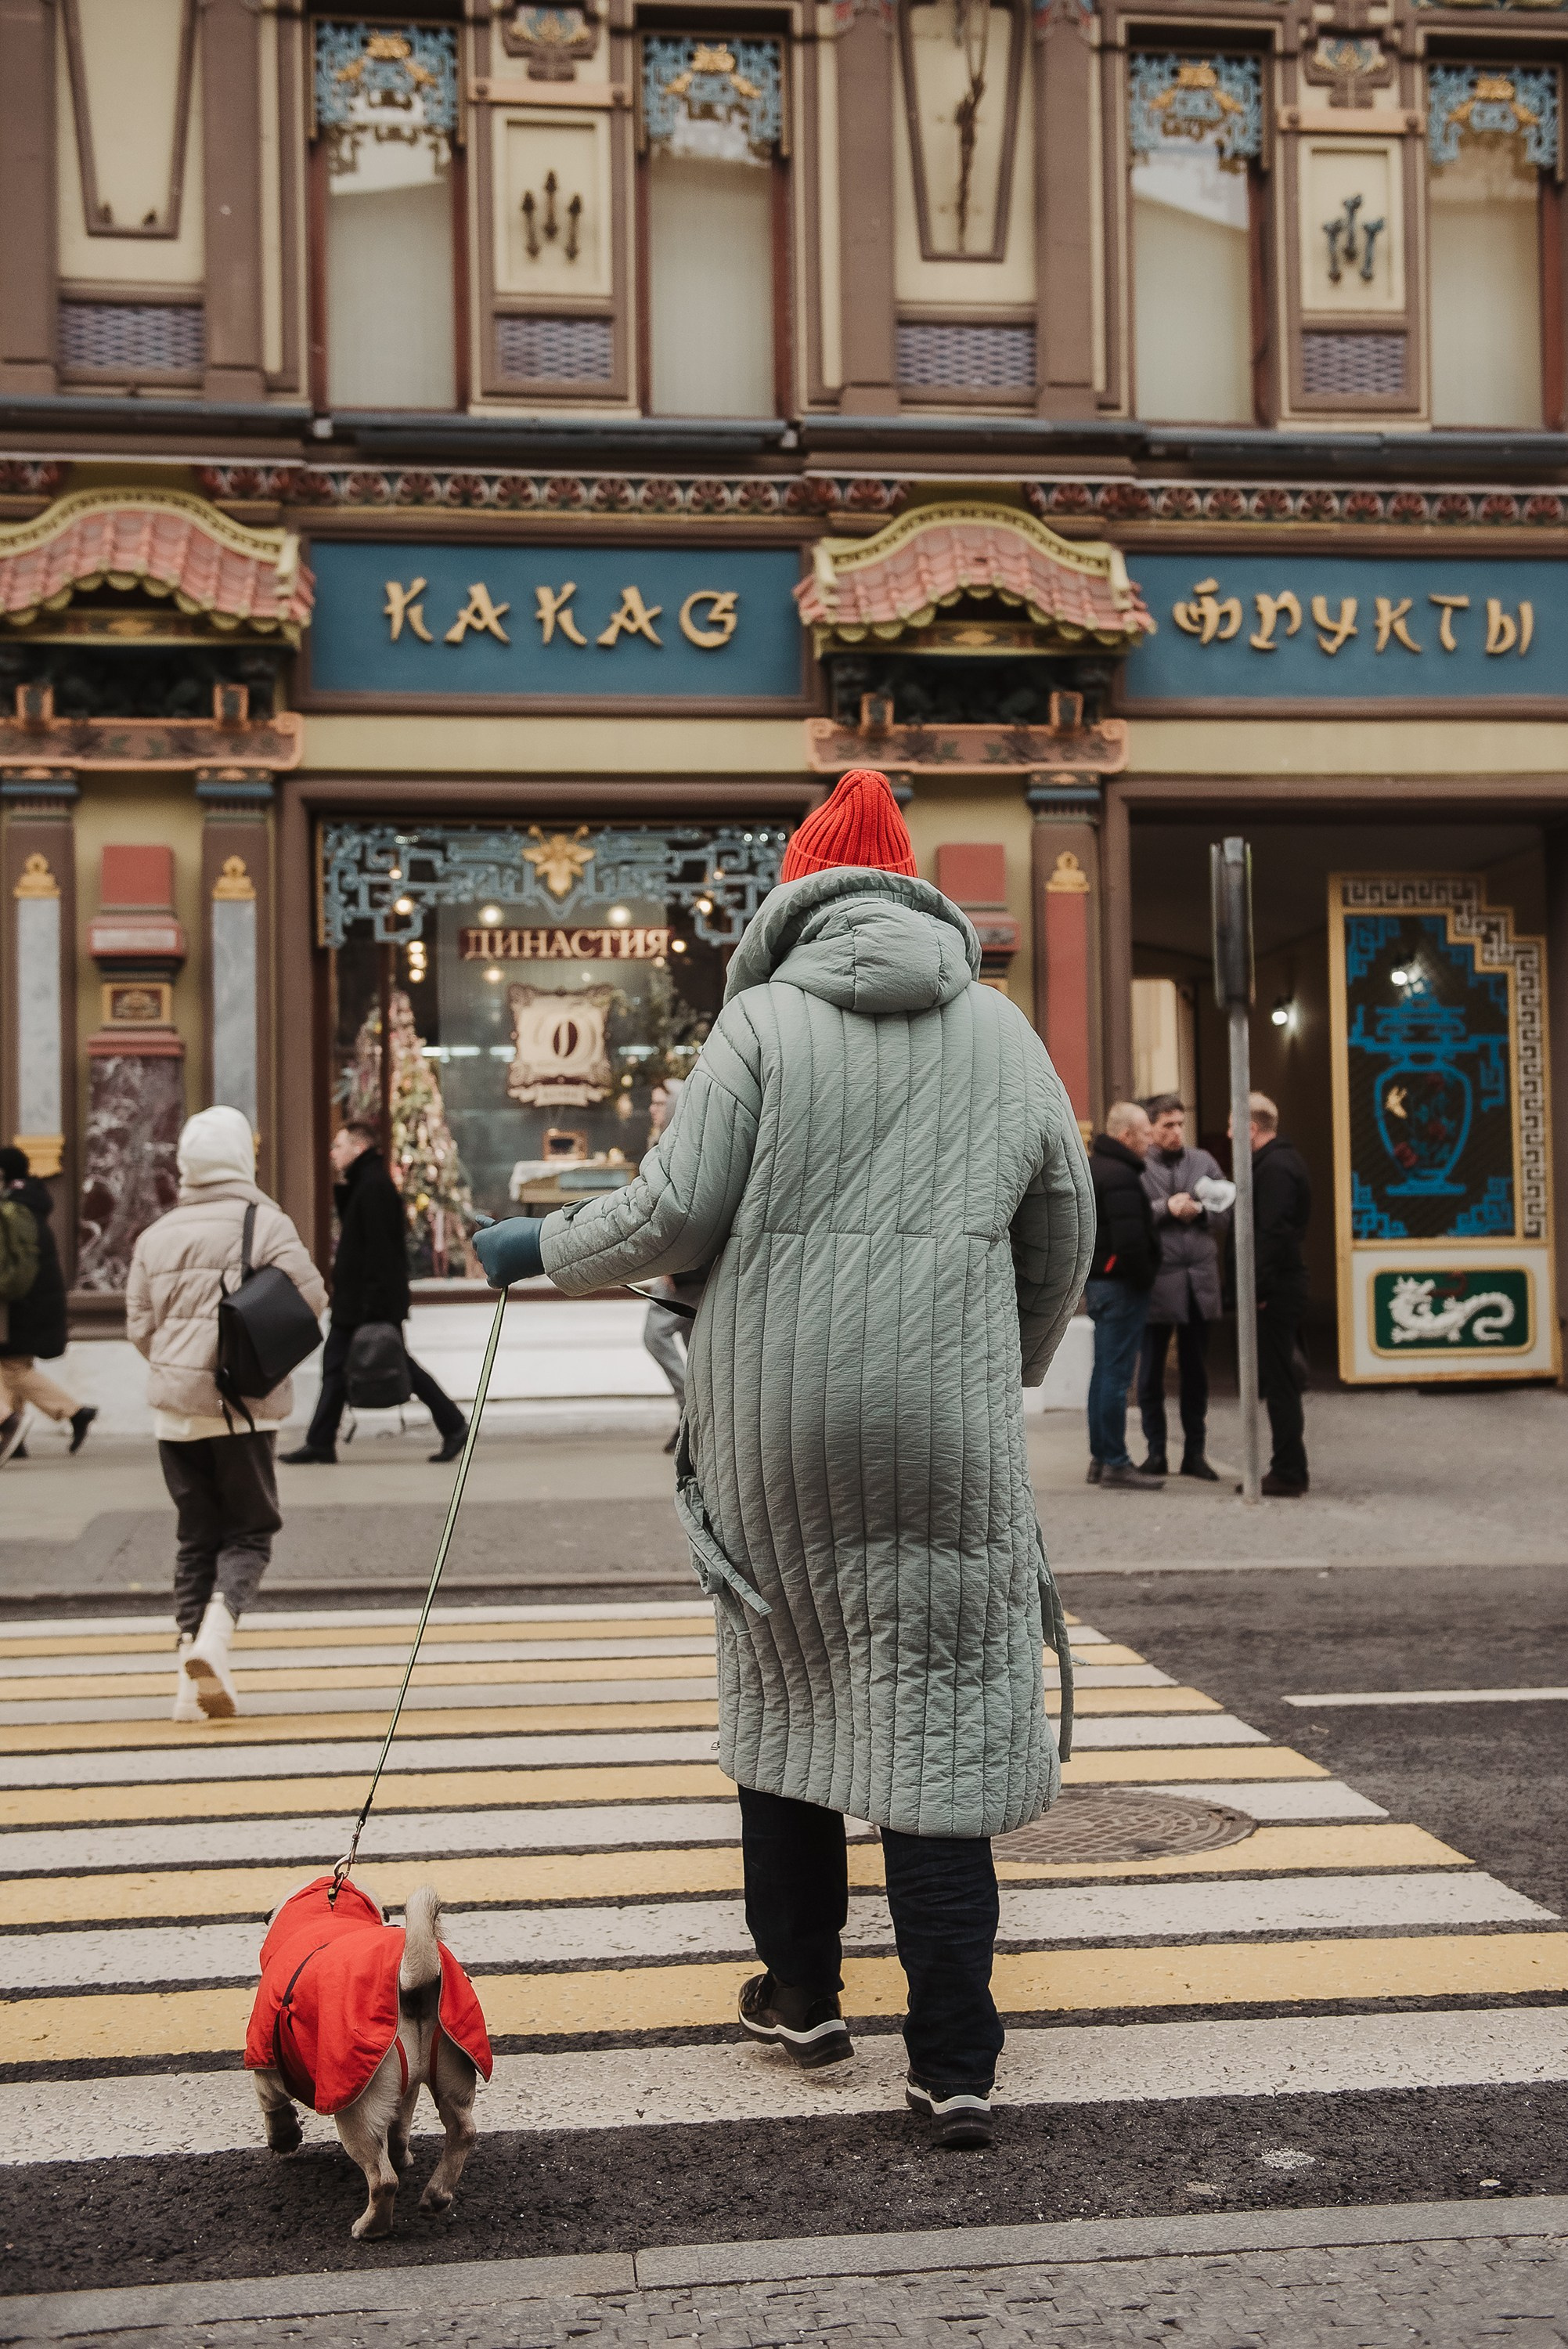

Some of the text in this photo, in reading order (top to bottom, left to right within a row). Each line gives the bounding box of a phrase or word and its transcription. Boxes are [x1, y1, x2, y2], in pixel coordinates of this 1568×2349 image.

[384, 576, 740, 648] КАКАО
[1172, 578, 1534, 655] ФРУКТЫ
[464, 929, 670, 959] ДИНАСТИЯ
